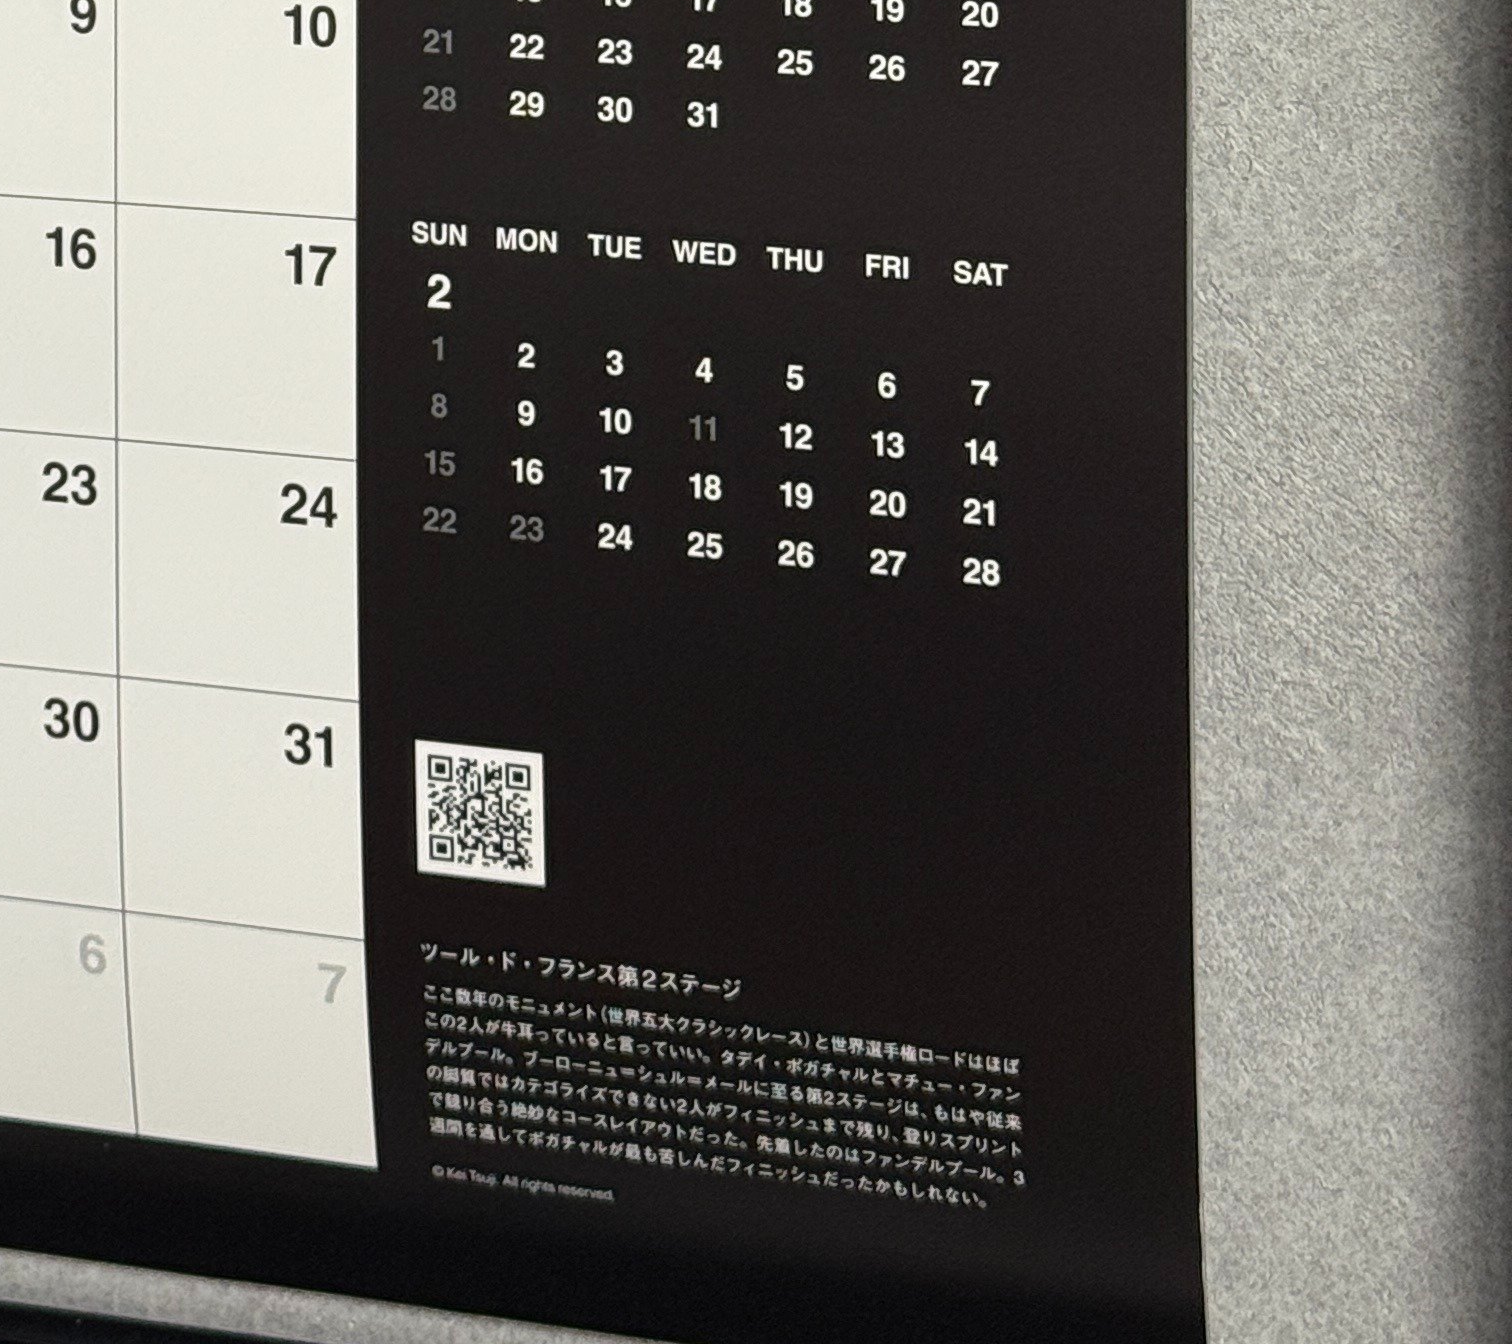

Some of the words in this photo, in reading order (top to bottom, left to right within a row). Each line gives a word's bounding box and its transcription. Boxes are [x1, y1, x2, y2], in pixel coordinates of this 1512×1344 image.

[283, 3, 338, 49] 10
[44, 225, 98, 271] 16
[284, 242, 338, 287] 17
[411, 220, 469, 248] SUN
[495, 226, 560, 255] MON
[586, 232, 643, 261] TUE
[671, 238, 738, 267] WED
[765, 245, 825, 274] THU
[864, 252, 911, 281] FRI
[952, 259, 1010, 288] SAT
[426, 272, 453, 311] 2
[430, 392, 448, 419] 8
[517, 399, 537, 428] 9
[598, 406, 634, 436] 10
[688, 414, 717, 442] 11
[778, 421, 814, 452] 12
[869, 429, 907, 460] 13
[963, 437, 1000, 468] 14
[41, 460, 99, 507] 23
[279, 482, 339, 529] 24
[42, 696, 101, 743] 30
[283, 721, 335, 769] 31
[78, 933, 108, 975] 6
[317, 962, 348, 1005] 7
